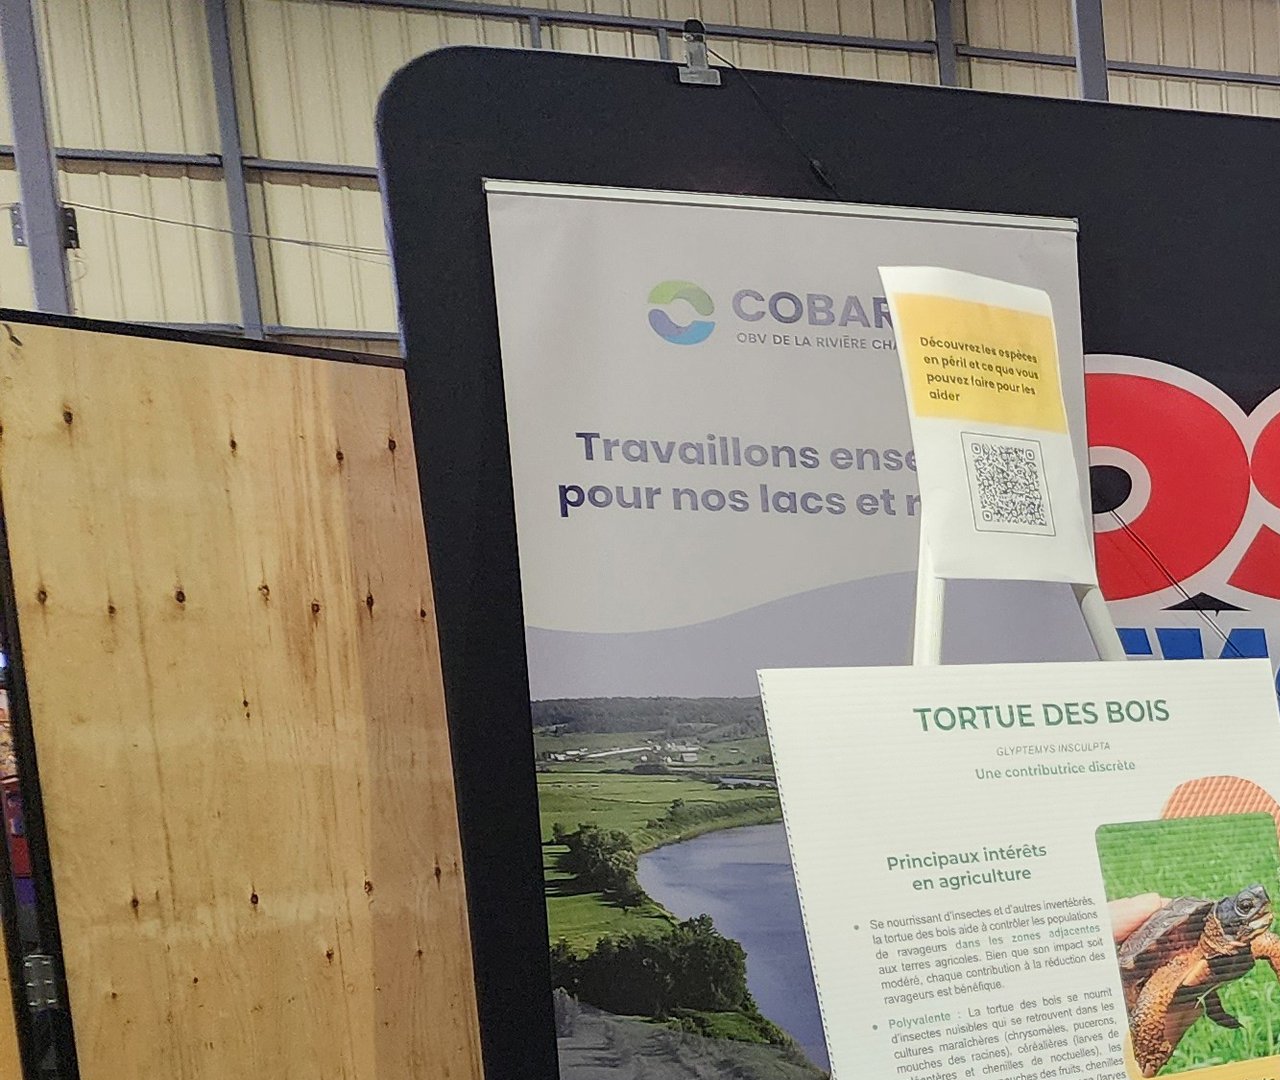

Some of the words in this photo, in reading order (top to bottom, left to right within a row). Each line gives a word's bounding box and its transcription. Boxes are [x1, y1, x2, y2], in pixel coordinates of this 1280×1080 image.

[919, 336, 980, 354] Découvrez
[981, 344, 996, 355] les
[998, 349, 1037, 363] espèces
[923, 356, 939, 364] en
[941, 356, 967, 369] péril
[968, 360, 980, 369] et
[981, 362, 993, 371] ce
[995, 365, 1014, 376] que
[1015, 368, 1038, 379] vous
[929, 388, 960, 401] aider
[575, 432, 819, 468] Travaillons
[558, 484, 661, 517] pour
[672, 488, 749, 512] nos
[759, 483, 846, 514] lacs
[856, 488, 896, 515] et
[913, 704, 1035, 731] TORTUE
[1042, 701, 1098, 726] DES
[1105, 699, 1169, 723] BOIS
[975, 768, 1001, 779] Une
[1005, 762, 1085, 777] contributrice
[1088, 759, 1135, 772] discrète
[886, 851, 980, 870] Principaux
[982, 843, 1046, 861] intérêts
[912, 878, 934, 890] en
[939, 868, 1031, 890] agriculture
